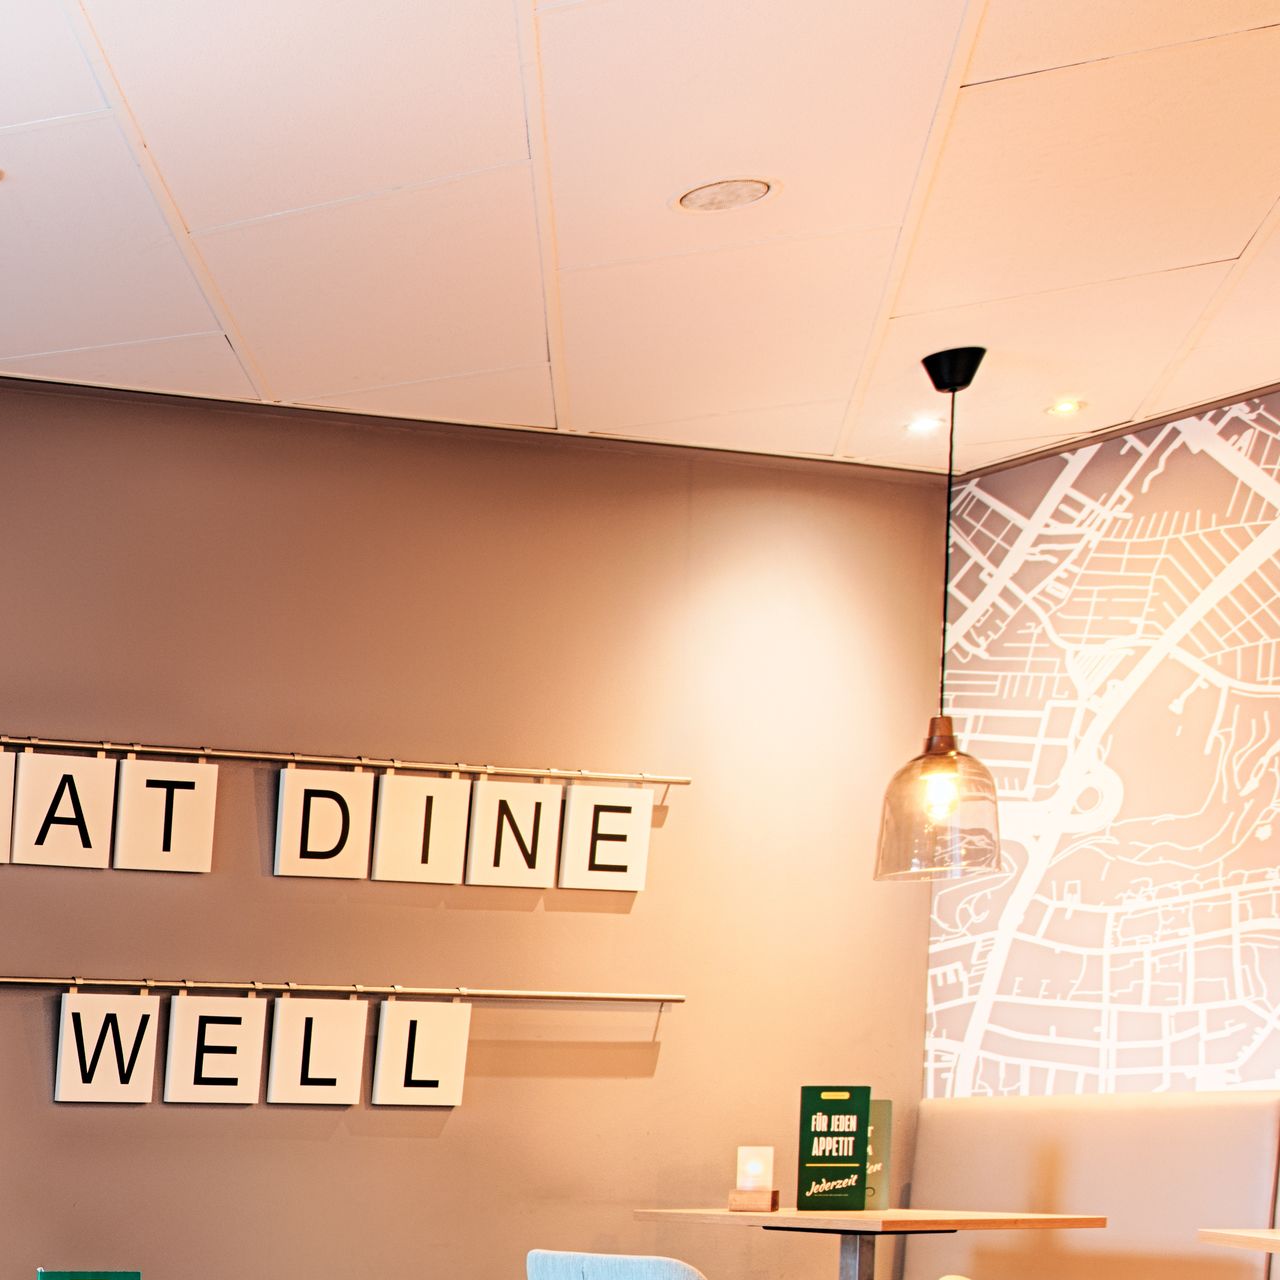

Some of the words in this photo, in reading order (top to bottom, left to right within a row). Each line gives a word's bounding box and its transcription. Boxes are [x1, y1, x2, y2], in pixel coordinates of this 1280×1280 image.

[299, 788, 632, 873] DINE
[72, 1011, 440, 1090] WELL
[811, 1112, 828, 1132] FÜR
[830, 1115, 857, 1132] JEDEN
[811, 1136, 855, 1157] APPETIT
[805, 1174, 859, 1197] Jederzeit
